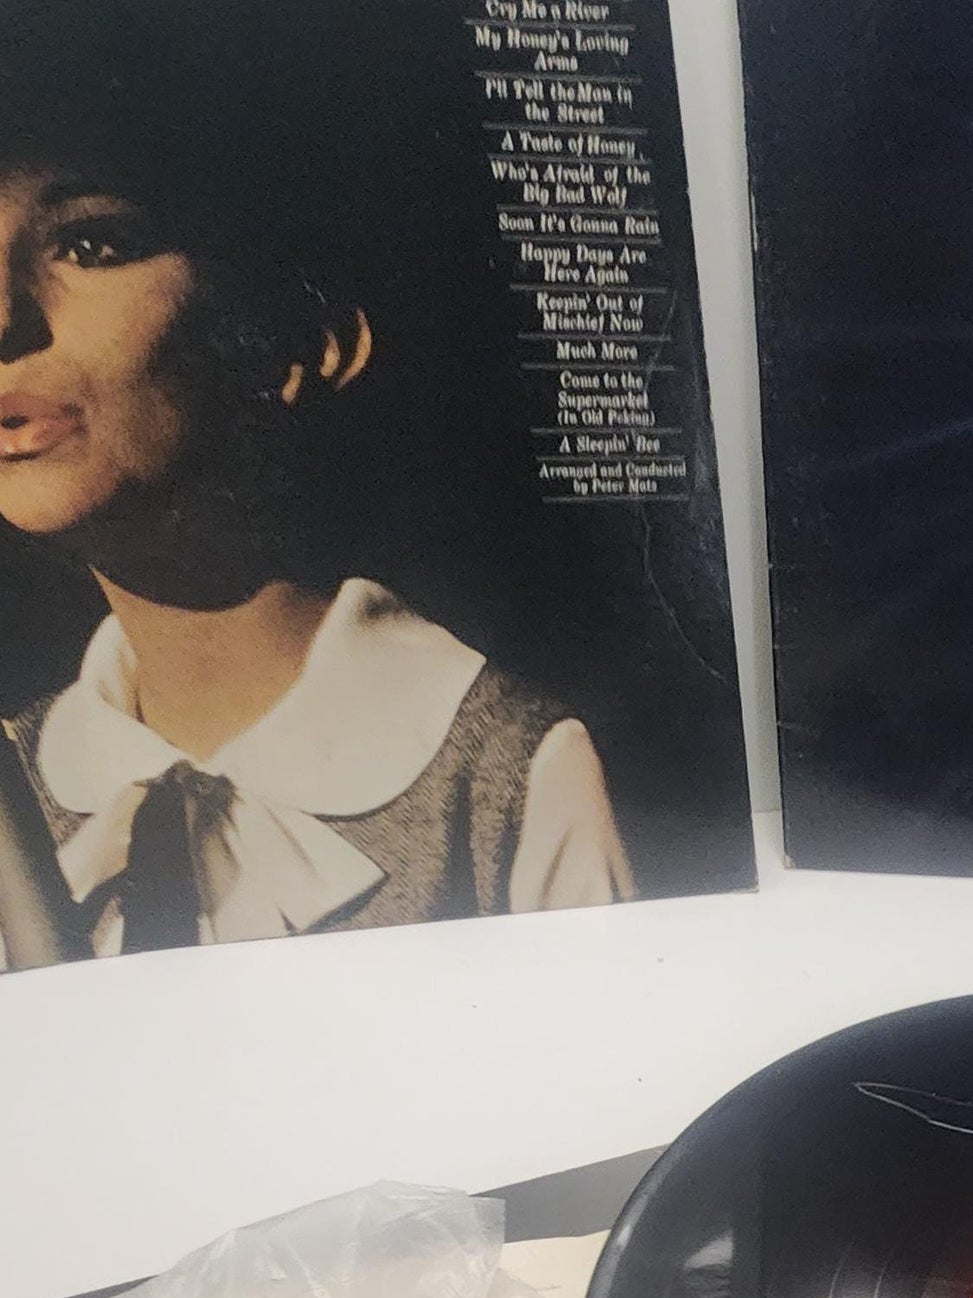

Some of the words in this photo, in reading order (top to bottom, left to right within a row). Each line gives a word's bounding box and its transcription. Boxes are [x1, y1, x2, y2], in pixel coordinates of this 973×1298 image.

[565, 0, 609, 21] River
[475, 25, 501, 50] My
[575, 29, 629, 55] Loving
[534, 51, 578, 71] Arms
[513, 78, 544, 100] Tell
[550, 80, 575, 101] the
[577, 81, 612, 103] Man
[525, 101, 549, 122] the
[557, 103, 605, 124] Street
[502, 131, 514, 151] A
[519, 131, 563, 152] Taste
[568, 133, 583, 157] of
[587, 135, 635, 159] Honey
[543, 163, 594, 184] Afraid
[604, 165, 618, 186] of
[626, 165, 651, 185] the
[523, 182, 550, 207] Big
[555, 183, 585, 204] Bad
[591, 185, 627, 208] Wolf
[498, 213, 534, 232] Soon
[570, 214, 618, 234] Gonna
[625, 215, 660, 235] Rain
[520, 242, 570, 264] Happy
[576, 243, 614, 266] Days
[619, 245, 647, 264] Are
[544, 263, 580, 282] Here
[584, 265, 629, 285] Again
[596, 294, 623, 312] Out
[609, 314, 643, 332] Now
[556, 340, 596, 360] Much
[601, 341, 638, 360] More
[560, 370, 600, 389] Come
[603, 372, 618, 388] to
[621, 372, 643, 388] the
[558, 391, 649, 411] Supermarket
[559, 436, 570, 453] A
[539, 461, 597, 480] Arranged
[600, 463, 622, 477] and
[626, 461, 687, 478] Conducted
[592, 478, 624, 493] Peter
